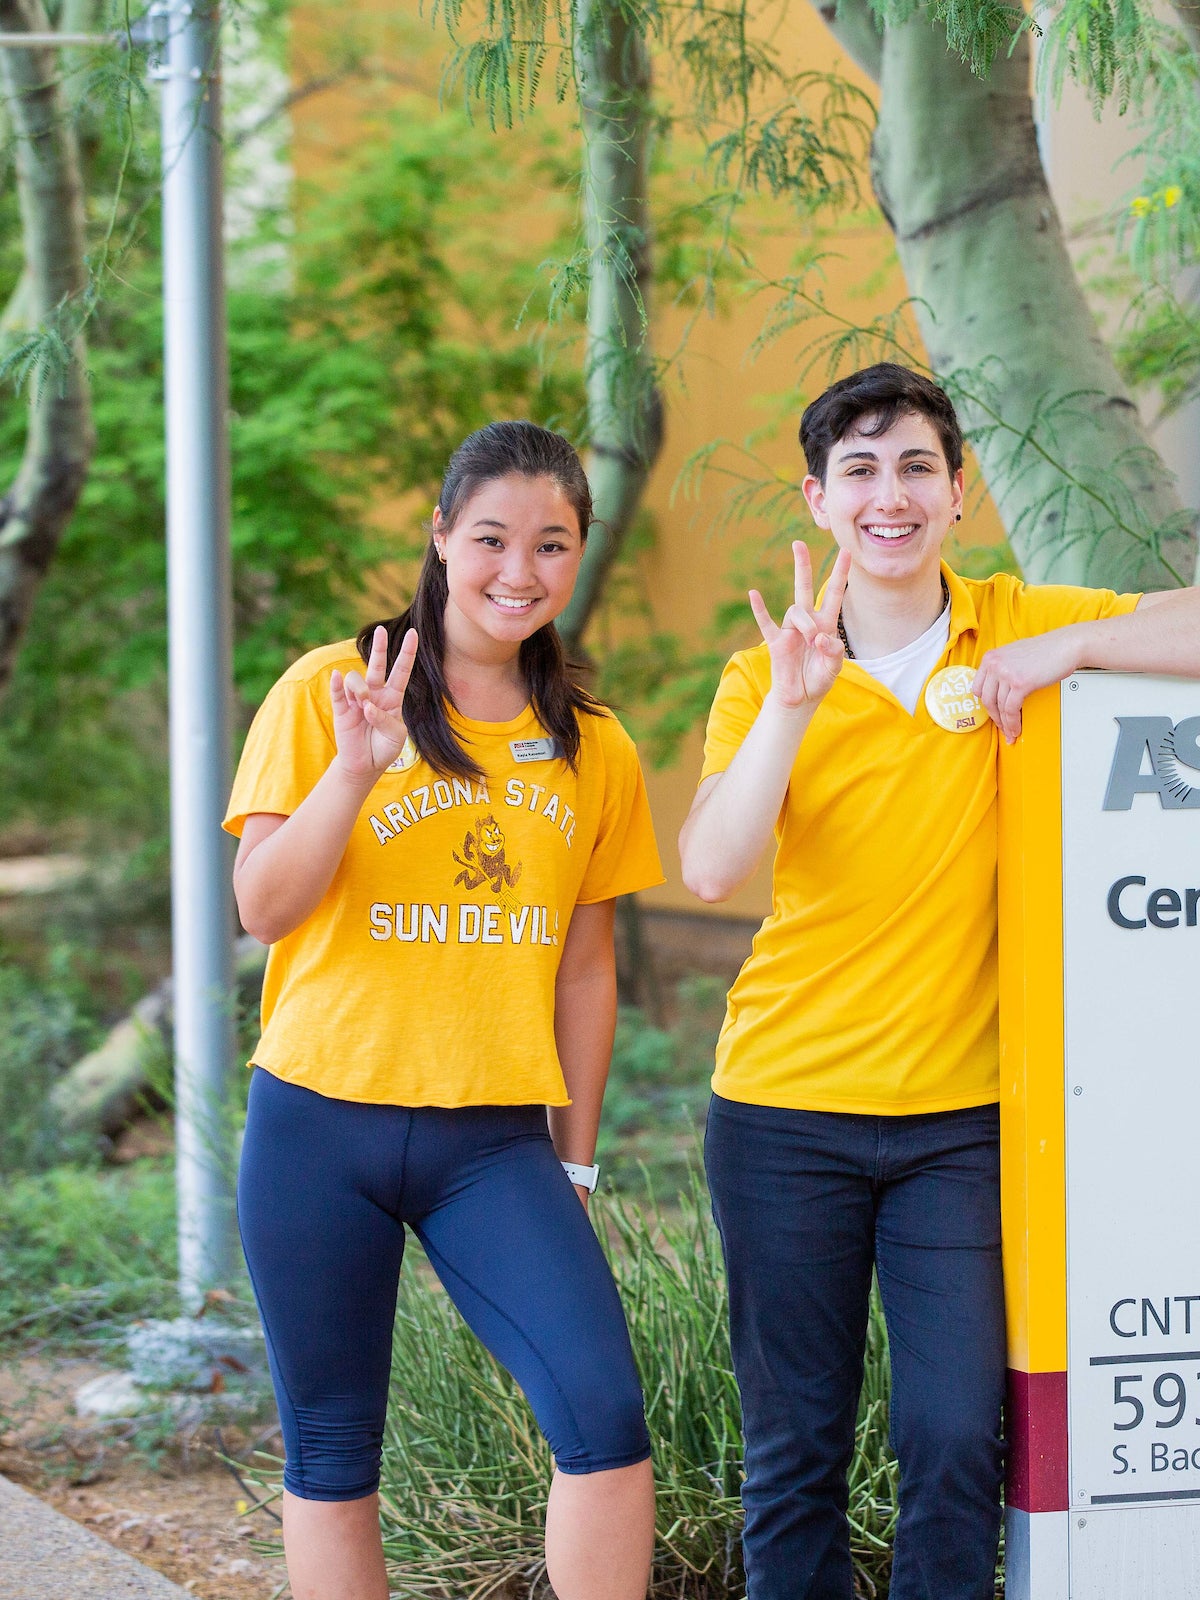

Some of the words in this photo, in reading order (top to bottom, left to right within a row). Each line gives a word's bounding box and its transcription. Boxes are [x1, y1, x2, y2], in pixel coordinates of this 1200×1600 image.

[943, 695, 981, 717] me!
[956, 716, 976, 729] ASU
[368, 776, 491, 846] ARIZONA
[369, 902, 449, 944] SUN
[1112, 1444, 1137, 1474] S.
